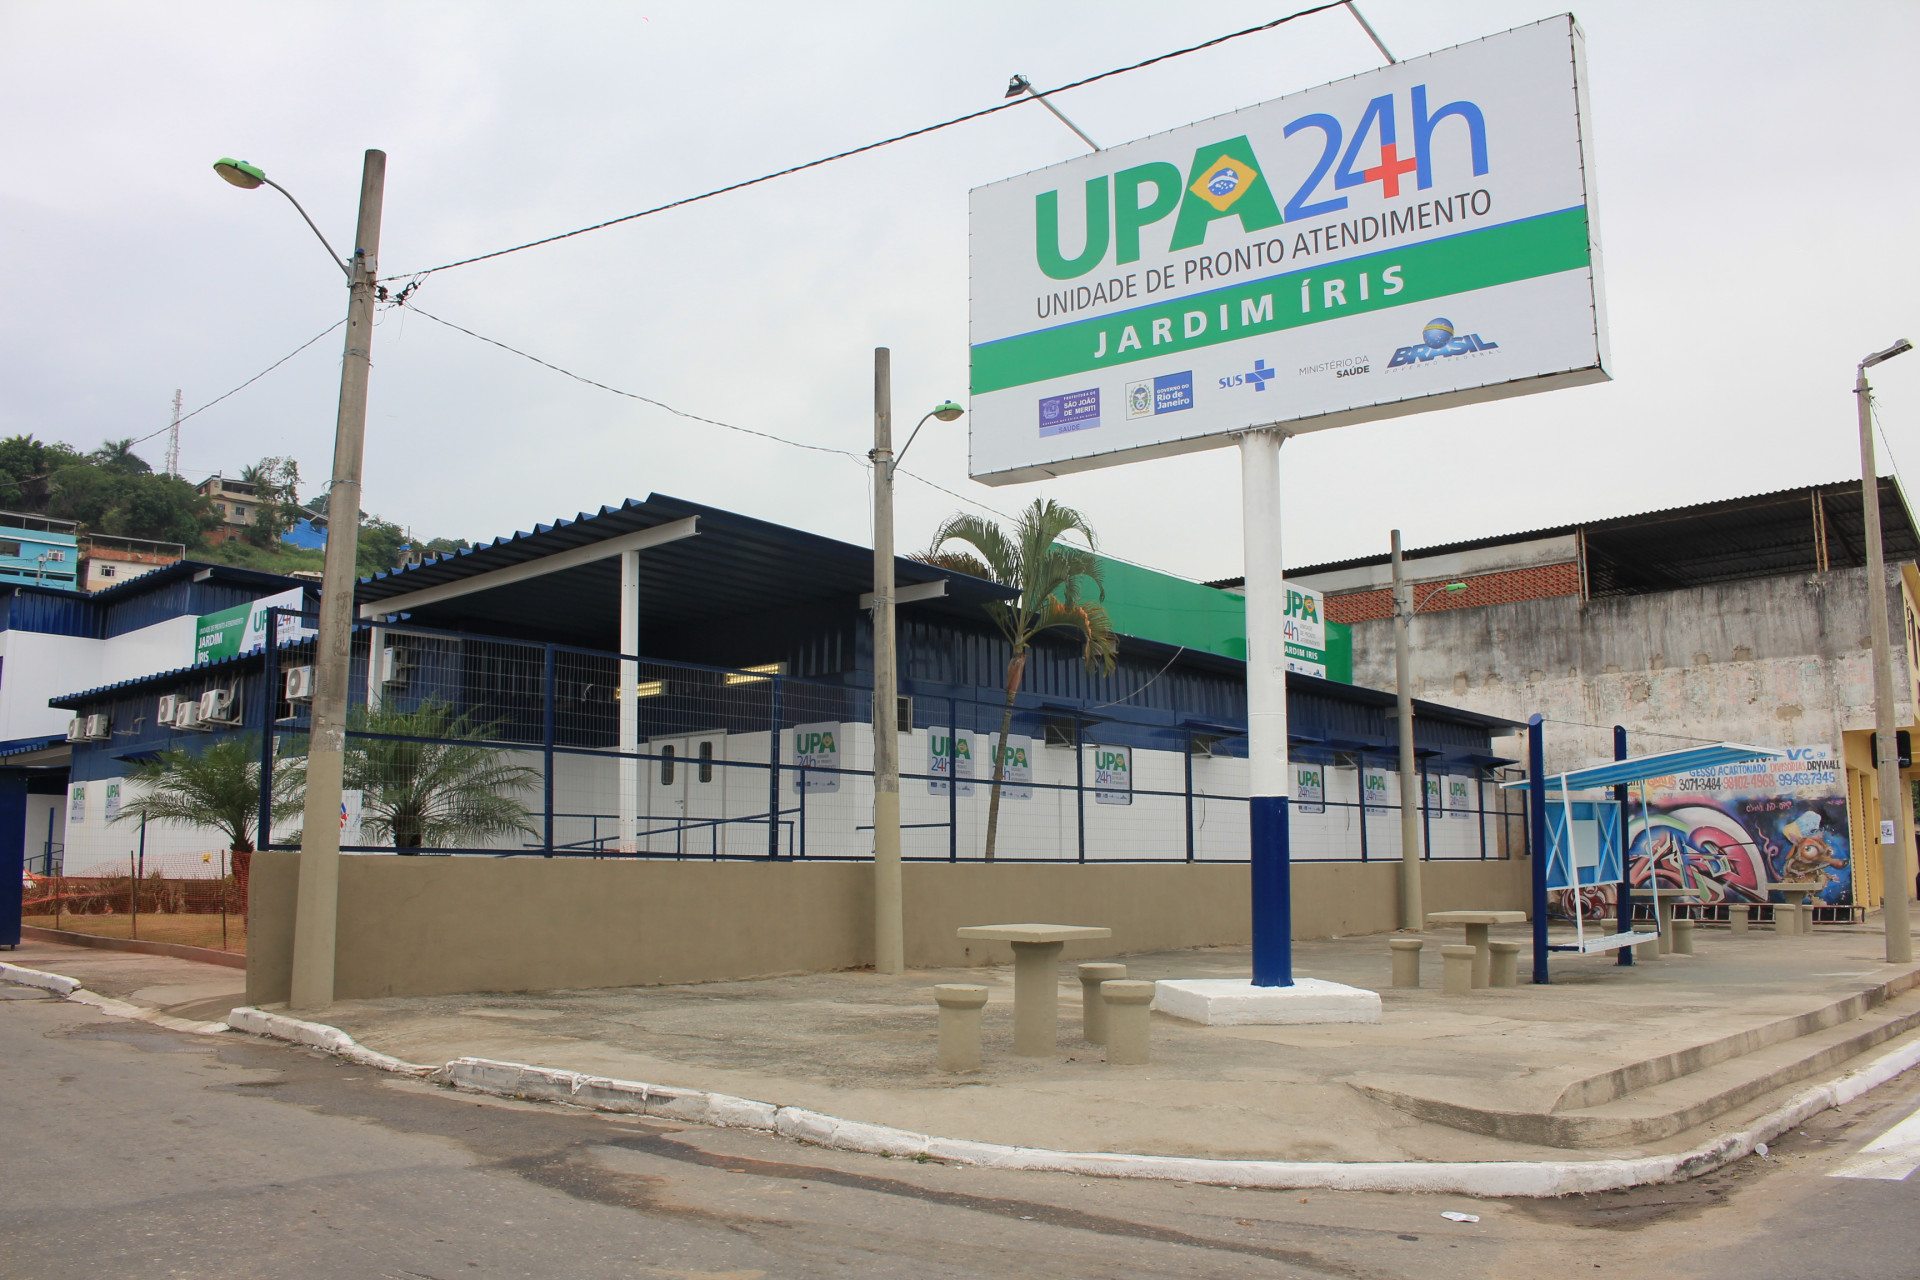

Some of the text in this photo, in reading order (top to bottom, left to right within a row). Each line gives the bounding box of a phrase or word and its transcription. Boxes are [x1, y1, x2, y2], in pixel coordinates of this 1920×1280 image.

[1036, 84, 1489, 280] UPA 24h
[1037, 189, 1491, 319] UNIDADE DE PRONTO ATENDIMENTO
[1094, 265, 1404, 358] JARDIM ÍRIS
[1387, 333, 1499, 368] BRASIL
[1299, 355, 1369, 376] MINISTÉRIO DA
[1336, 365, 1370, 378] SAÚDE
[1157, 385, 1180, 394] GOVERNO
[1218, 374, 1243, 389] SUS
[1063, 397, 1096, 409] SÃO JOÃO
[1157, 391, 1183, 402] Rio de
[1157, 398, 1190, 410] Janeiro
[1075, 405, 1096, 414] MERITI
[1283, 620, 1299, 642] 4h
[198, 631, 223, 649] JARDIM
[1284, 644, 1305, 657] ARDIM
[797, 731, 836, 755] UPA
[1095, 751, 1127, 772] UPA
[1689, 766, 1717, 778] GESSO
[1718, 763, 1767, 776] ACARTONADO
[1807, 759, 1841, 773] DRYWALL
[1096, 769, 1112, 785] 24h
[1298, 770, 1320, 787] UPA
[1365, 775, 1386, 791] UPA
[1449, 782, 1467, 797] UPA
